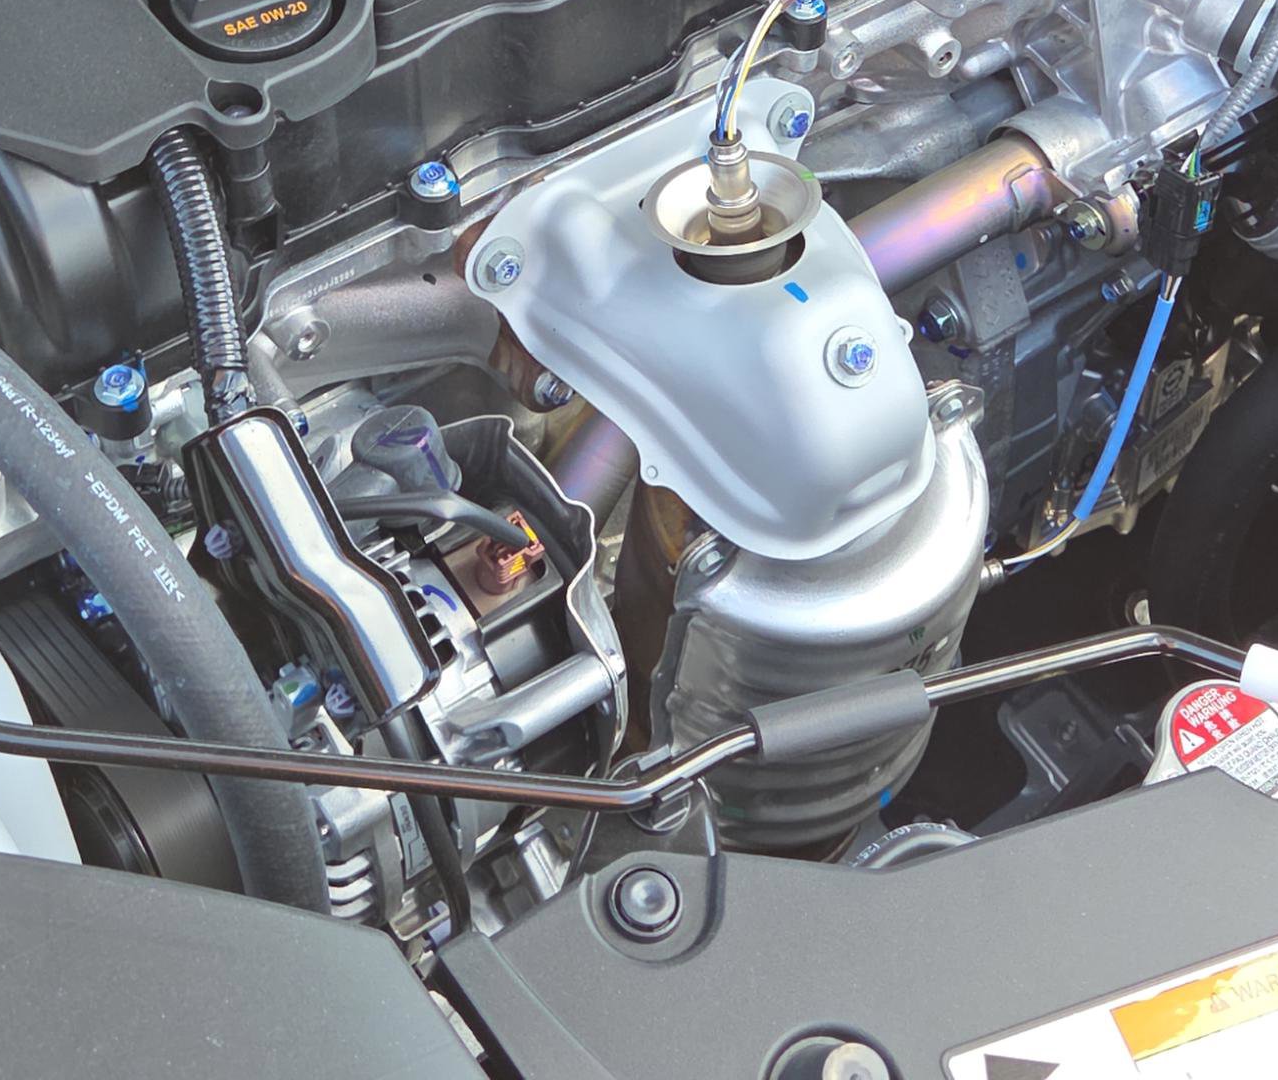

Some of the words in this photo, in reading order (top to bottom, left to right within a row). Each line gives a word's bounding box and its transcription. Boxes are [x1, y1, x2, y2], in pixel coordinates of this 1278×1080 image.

[223, 16, 259, 37] SAE
[260, 0, 309, 25] 0W-20
[20, 404, 75, 459] R-1234yf
[126, 525, 157, 560] PET
[1179, 688, 1221, 719] DANGER
